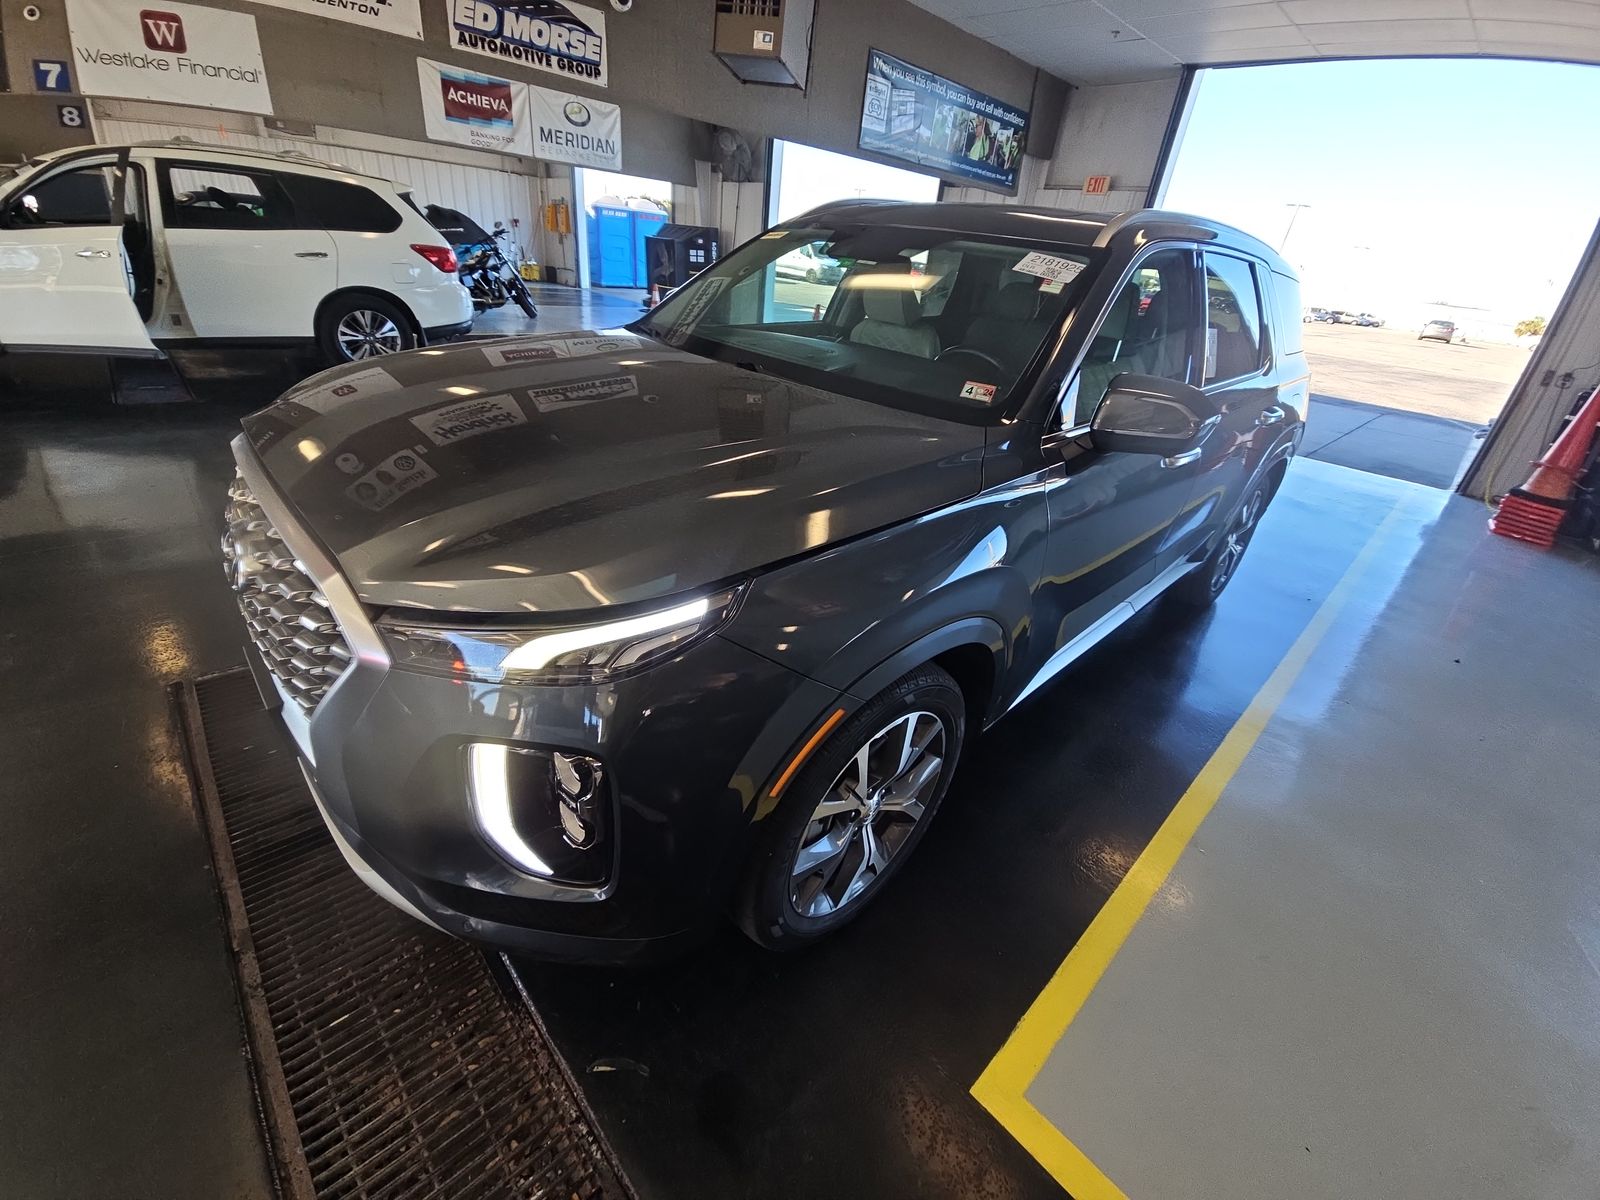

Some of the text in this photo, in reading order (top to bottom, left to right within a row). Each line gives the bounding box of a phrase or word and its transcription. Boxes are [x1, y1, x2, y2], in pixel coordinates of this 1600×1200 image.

[312, 0, 380, 17] ENTON
[144, 19, 180, 48] W
[454, 1, 602, 62] ED MORSE
[76, 47, 170, 72] Westlake
[458, 31, 602, 79] AUTOMOTIVE GROUP
[39, 63, 62, 88] 7
[873, 56, 893, 74] When
[892, 67, 905, 80] you
[905, 71, 916, 84] see
[915, 74, 926, 88] this
[946, 88, 957, 100] you
[957, 93, 967, 104] can
[967, 94, 977, 109] buy
[976, 100, 986, 111] and
[986, 103, 995, 113] sell
[447, 86, 510, 113] ACHIEVA
[61, 106, 82, 127] 8
[470, 130, 516, 145] BANKING FOR
[540, 126, 616, 155] MERIDIAN
[1086, 177, 1107, 193] EXIT
[1031, 255, 1085, 274] 2181925
[965, 386, 975, 396] 4
